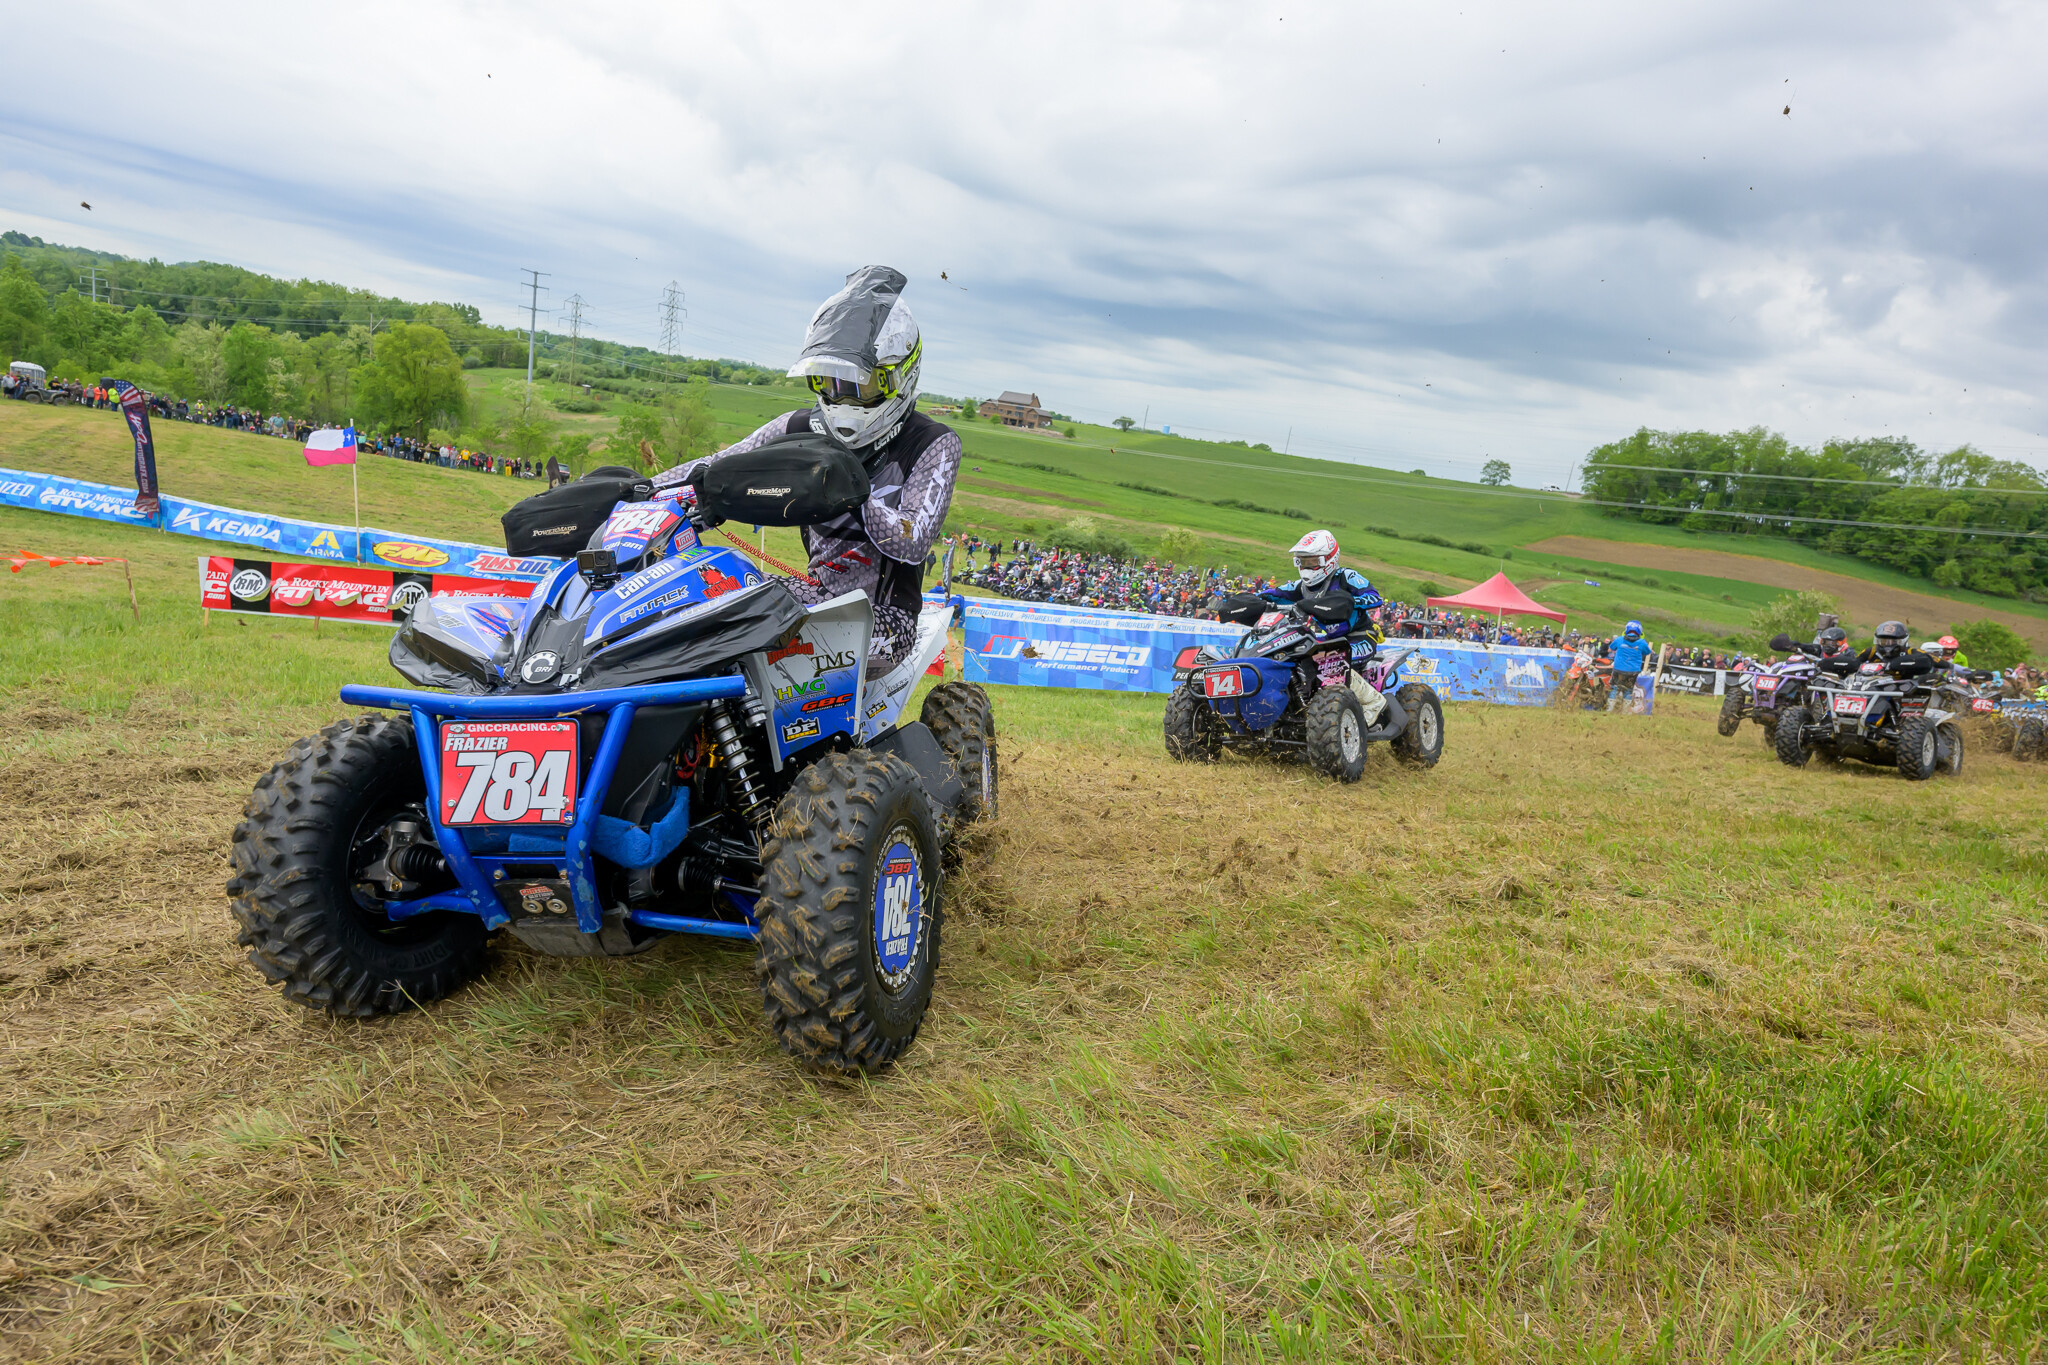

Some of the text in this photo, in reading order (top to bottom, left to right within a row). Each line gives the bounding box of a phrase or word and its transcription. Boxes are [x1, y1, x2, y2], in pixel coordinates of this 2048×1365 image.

[0, 481, 35, 497] IZED
[58, 488, 135, 506] ROCKY MOUNTA
[206, 517, 280, 543] KENDA
[604, 510, 671, 537] 784
[374, 543, 449, 563] FMF
[604, 541, 643, 550] can-am
[674, 547, 708, 561] HVG
[471, 555, 549, 574] AMSOIL
[292, 577, 390, 593] ROCKY MOUNTAIN
[614, 562, 675, 600] can-am
[970, 608, 1014, 619] PROGRESSIVE
[1021, 613, 1062, 623] PROGRESSIVE
[1069, 618, 1109, 627] PROGRESSIVE
[1116, 621, 1155, 630] PROGRESSIVE
[767, 642, 814, 666] EDGEWOOD
[810, 650, 856, 671] TMS
[1035, 661, 1139, 675] Performance Products
[1211, 674, 1236, 696] 14
[1400, 674, 1450, 684] RIDER'S GOLD
[777, 678, 825, 700] HVG
[801, 693, 853, 711] GBC
[1835, 700, 1864, 713] 208
[467, 723, 570, 732] GNCCRACING.CM
[444, 737, 509, 751] FRAZIER
[448, 750, 571, 823] 784
[886, 863, 912, 874] GBC
[882, 874, 913, 941] 784
